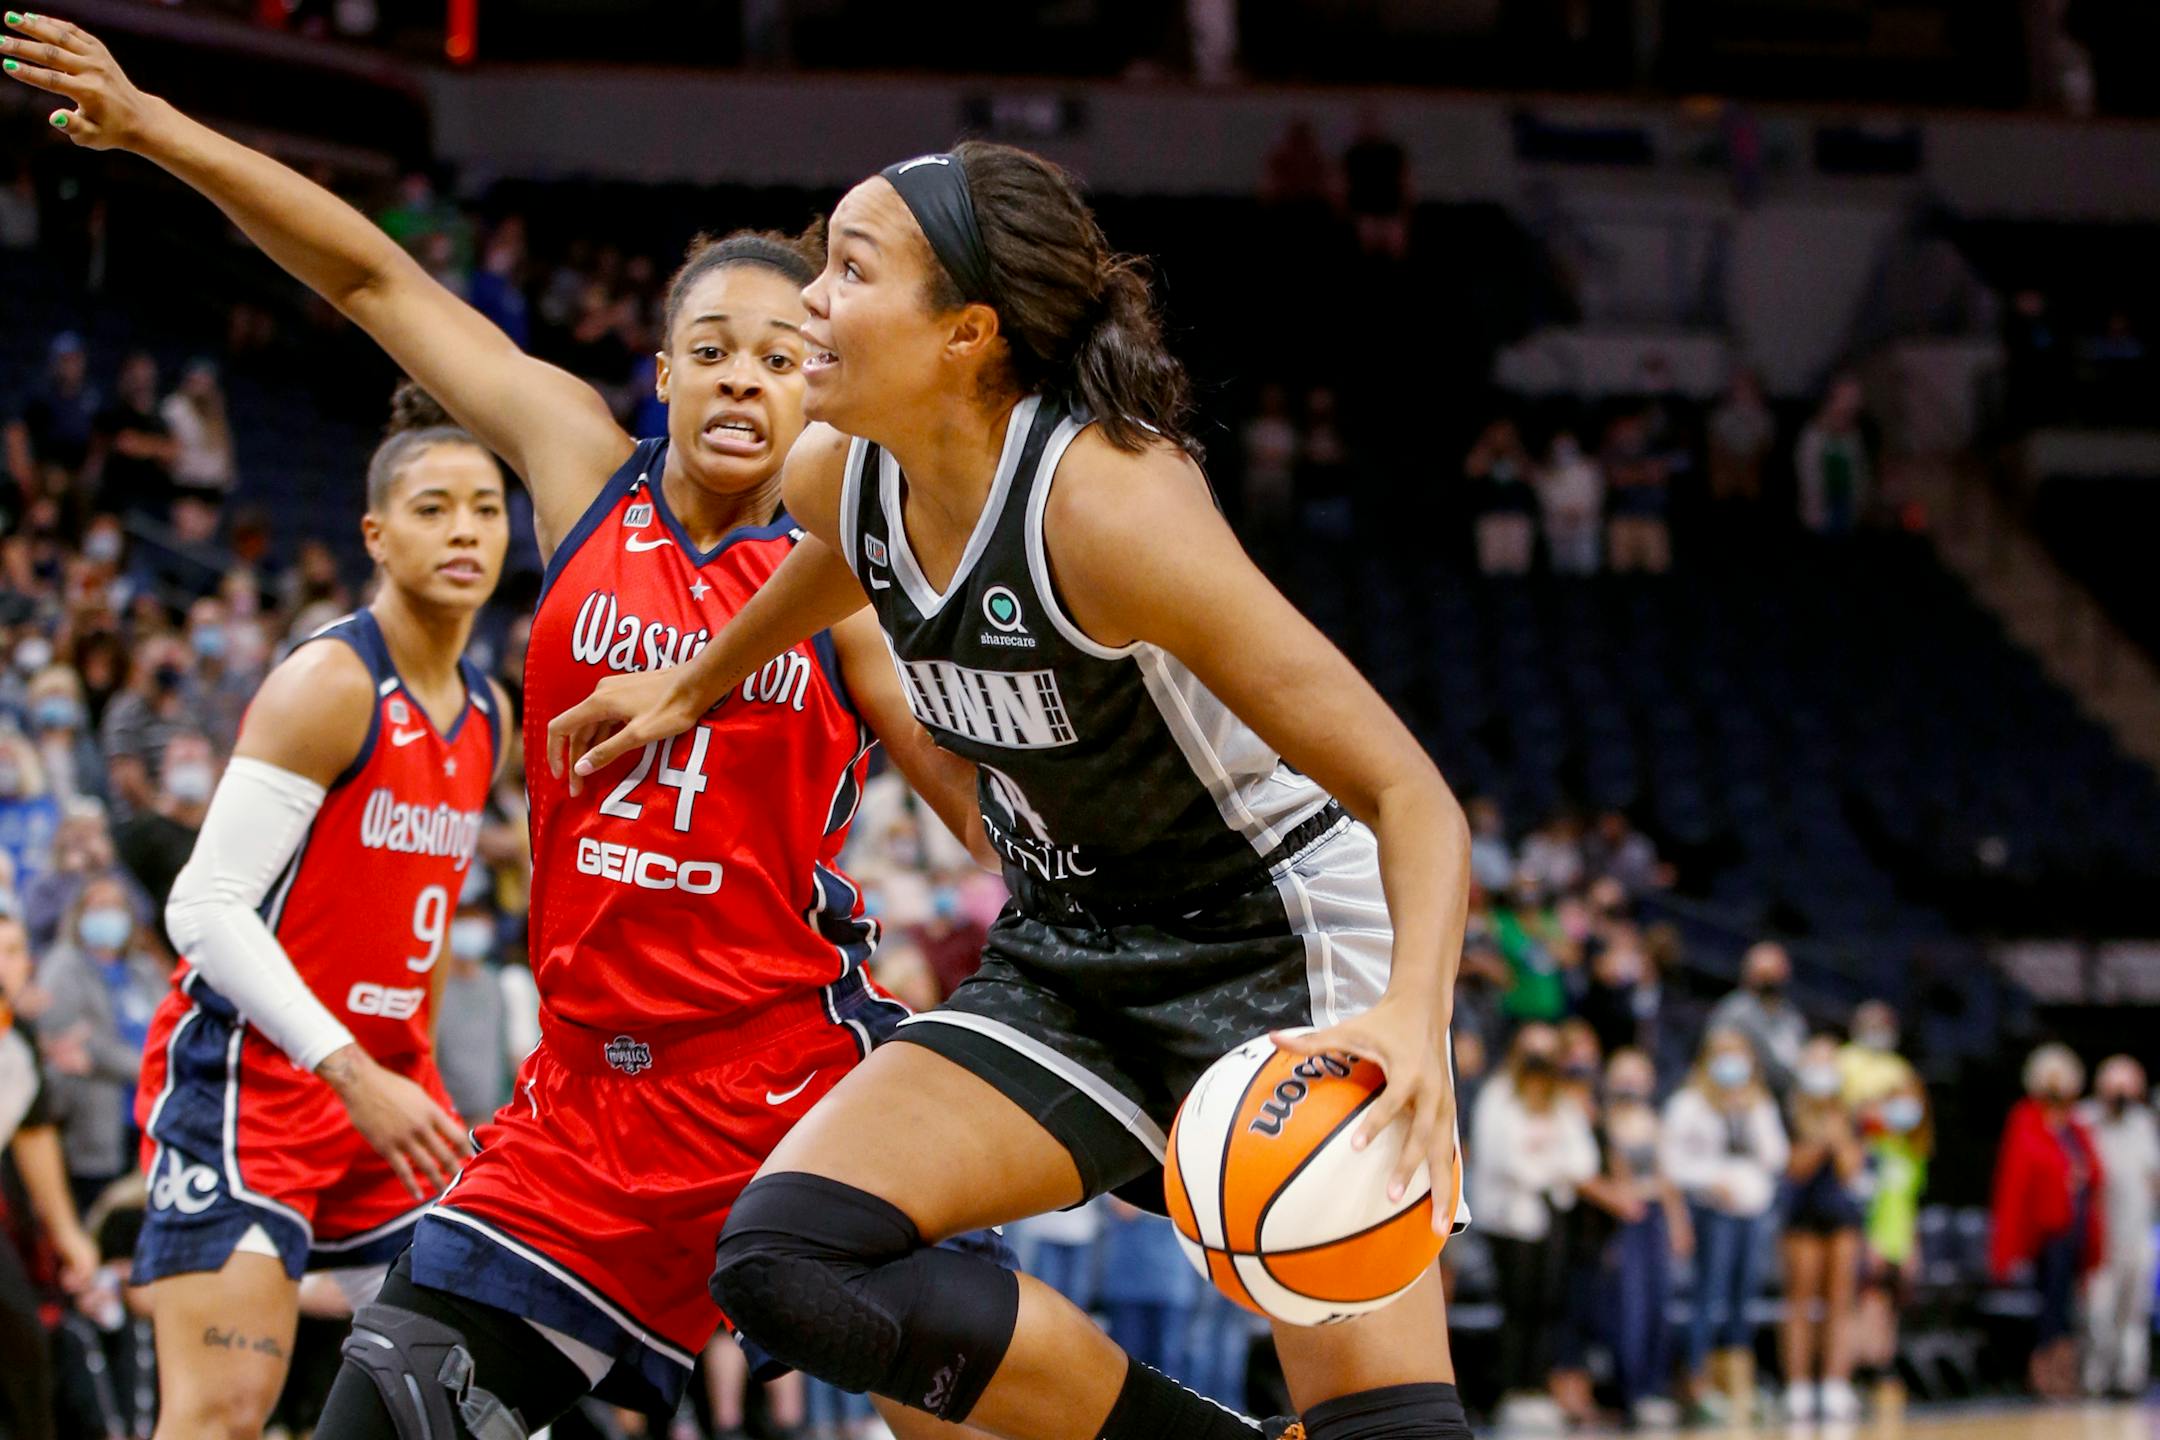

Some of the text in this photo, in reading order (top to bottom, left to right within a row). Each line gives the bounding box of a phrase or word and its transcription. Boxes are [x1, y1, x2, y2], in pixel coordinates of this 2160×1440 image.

[572, 588, 811, 712] Washion
[980, 632, 1036, 648] sharecare
[599, 725, 708, 833] 24
[577, 837, 724, 895] GEICO
[406, 885, 448, 973] 9
